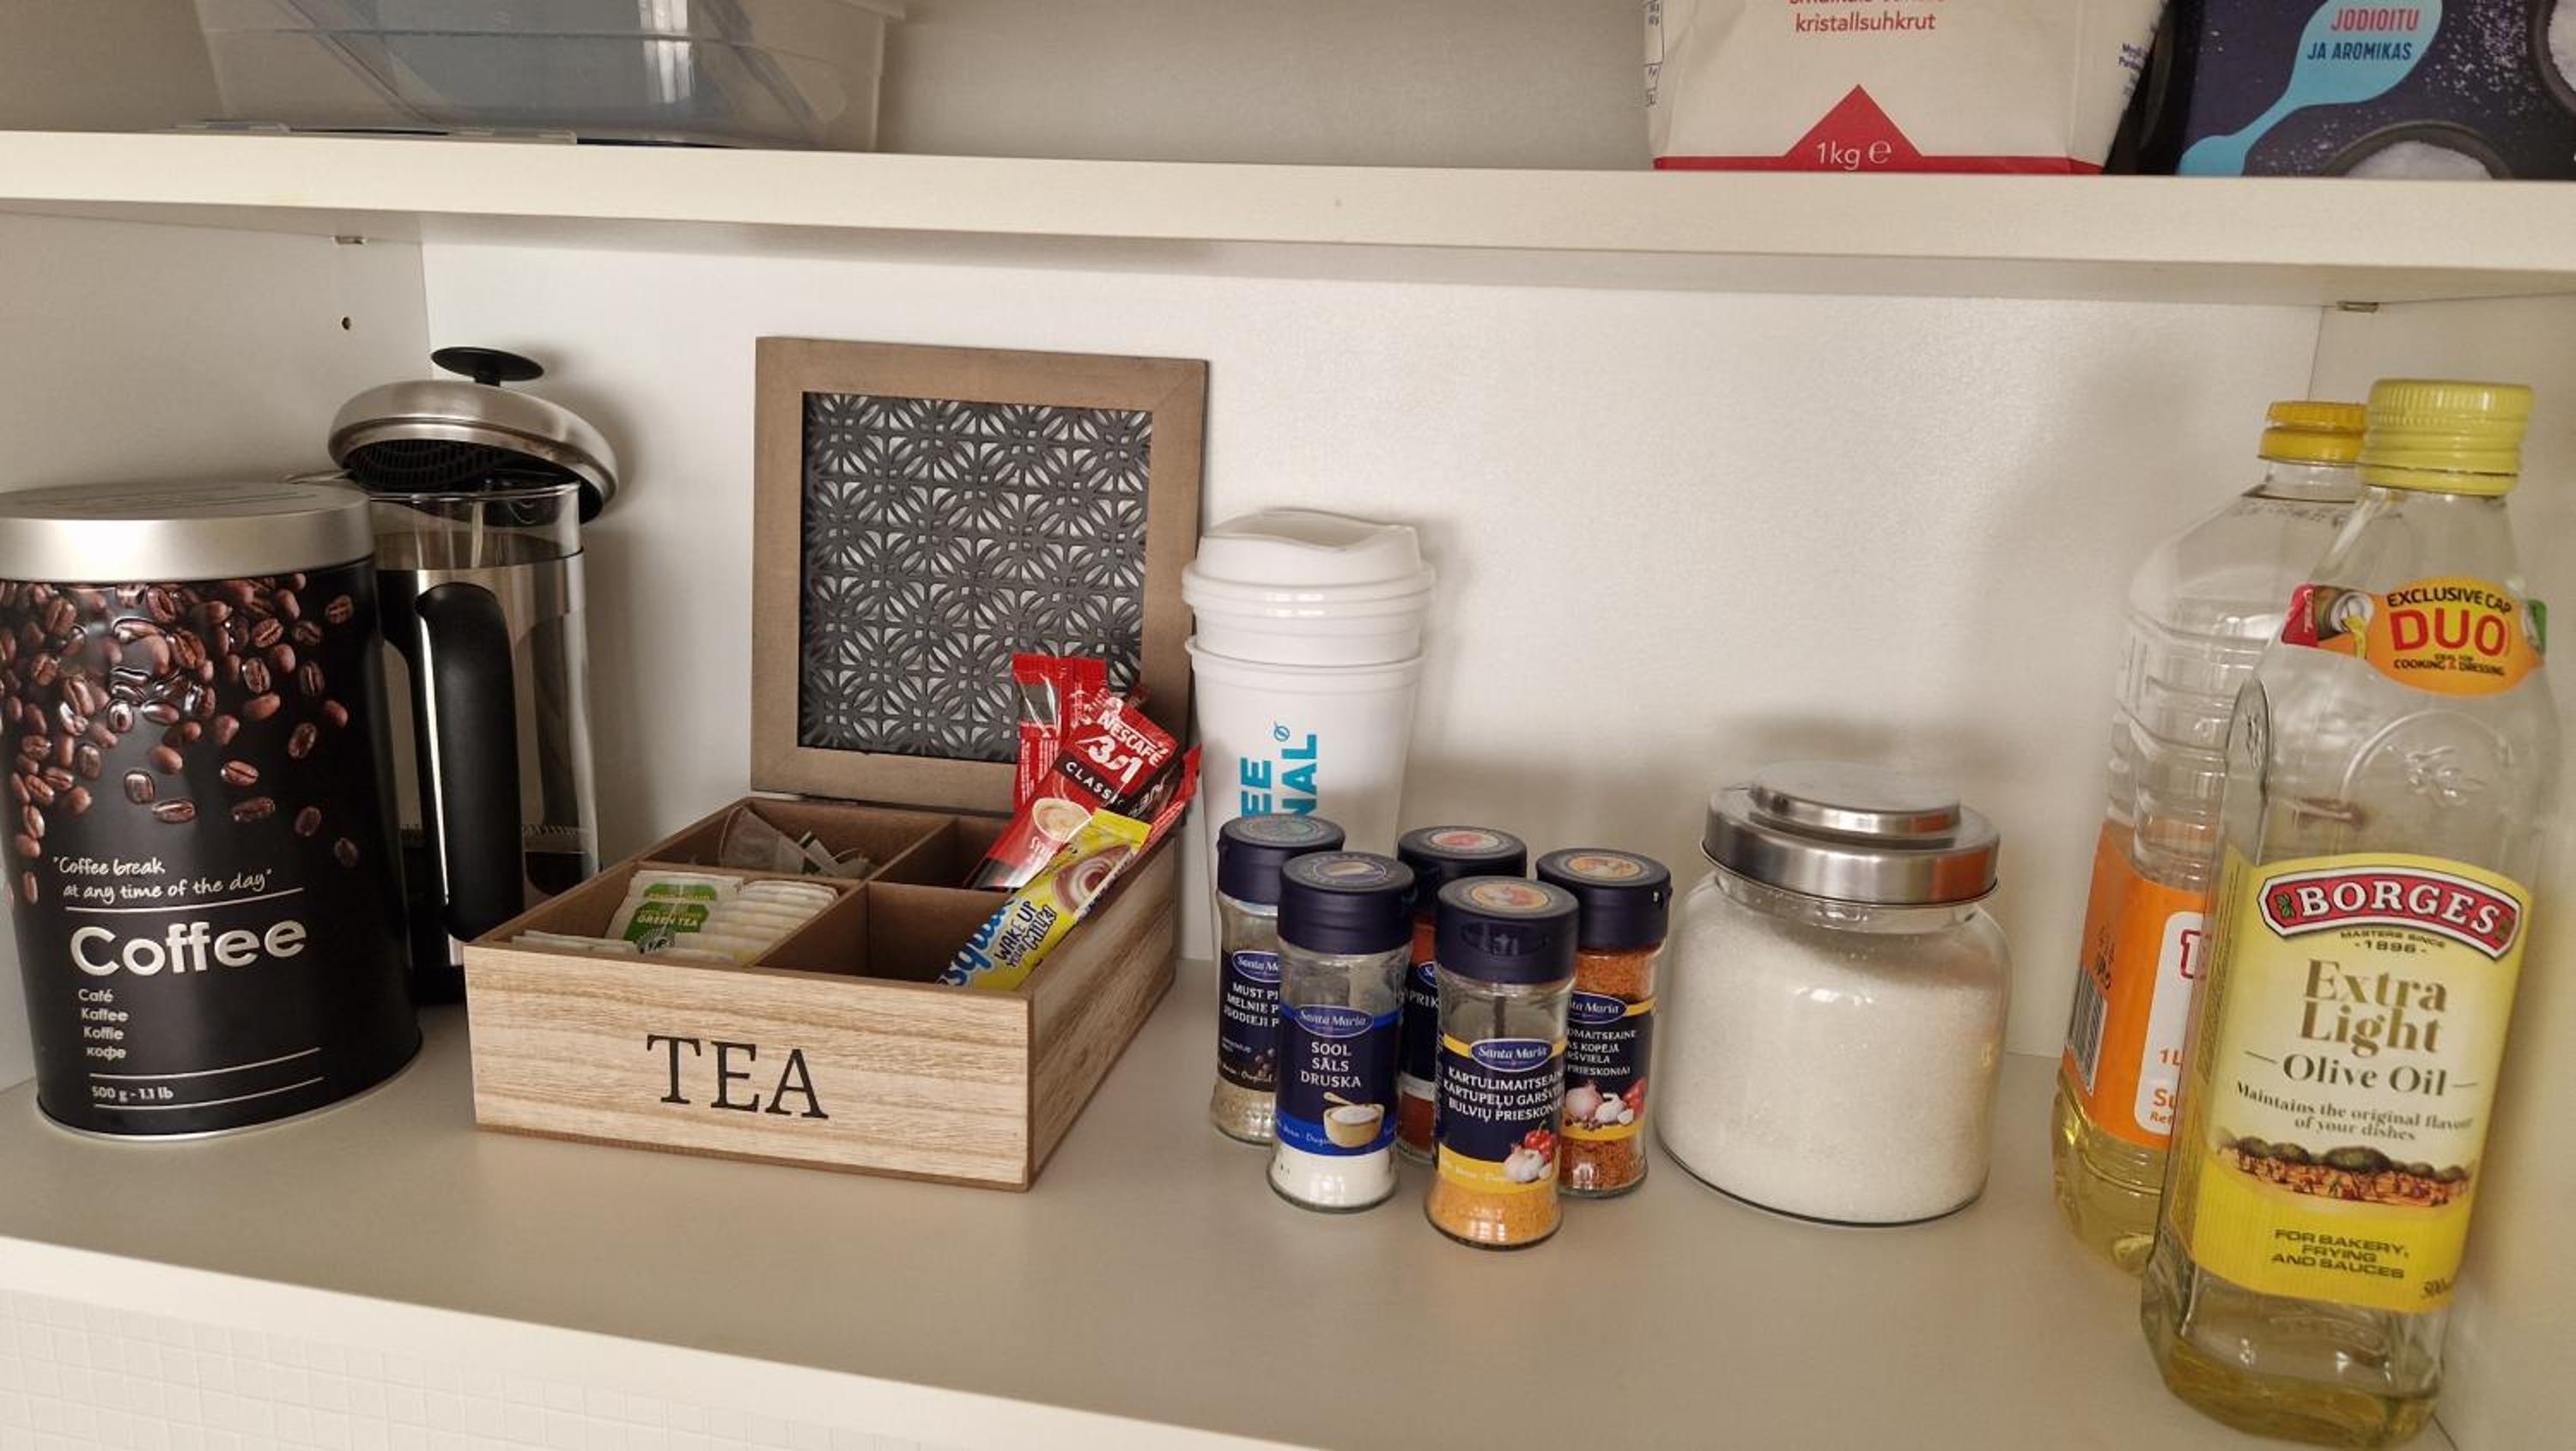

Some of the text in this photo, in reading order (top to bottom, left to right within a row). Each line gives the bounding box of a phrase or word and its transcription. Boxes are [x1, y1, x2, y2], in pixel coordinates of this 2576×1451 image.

[1795, 10, 1936, 32] kristallsuhkrut
[2330, 7, 2419, 31] JODIOITU
[2307, 41, 2412, 61] JA AROMIKAS
[1817, 140, 1861, 170] 1kg
[2386, 587, 2512, 614] EXCLUSIVE CAP
[2390, 607, 2506, 657] DUO
[112, 857, 166, 876] break
[63, 884, 80, 898] at
[83, 886, 115, 905] any
[121, 883, 162, 899] time
[167, 880, 188, 896] of
[192, 877, 223, 894] the
[2296, 880, 2500, 935] BORGES
[70, 920, 307, 976] Coffee
[78, 989, 114, 1003] Café
[1233, 982, 1267, 999] MUST
[2305, 958, 2447, 1013] Extra
[82, 1007, 129, 1023] Kaffee
[1299, 1009, 1368, 1027] Santa Maria
[83, 1026, 125, 1041] Koffie
[2299, 1000, 2442, 1059] Light
[1311, 1041, 1352, 1057] SOOL
[1478, 1045, 1512, 1059] Santa
[647, 1034, 829, 1120] TEA
[1300, 1071, 1362, 1088] DRUSKA
[2283, 1053, 2447, 1096] Olive Oil
[92, 1085, 117, 1099] 500
[2236, 1080, 2316, 1115] Maintains
[2320, 1102, 2347, 1119] the
[2350, 1108, 2421, 1129] original
[2293, 1114, 2416, 1142] of your dishes
[2275, 1229, 2316, 1244] FOR
[2301, 1243, 2378, 1263] FRYING
[2271, 1253, 2404, 1279] AND SAUCES
